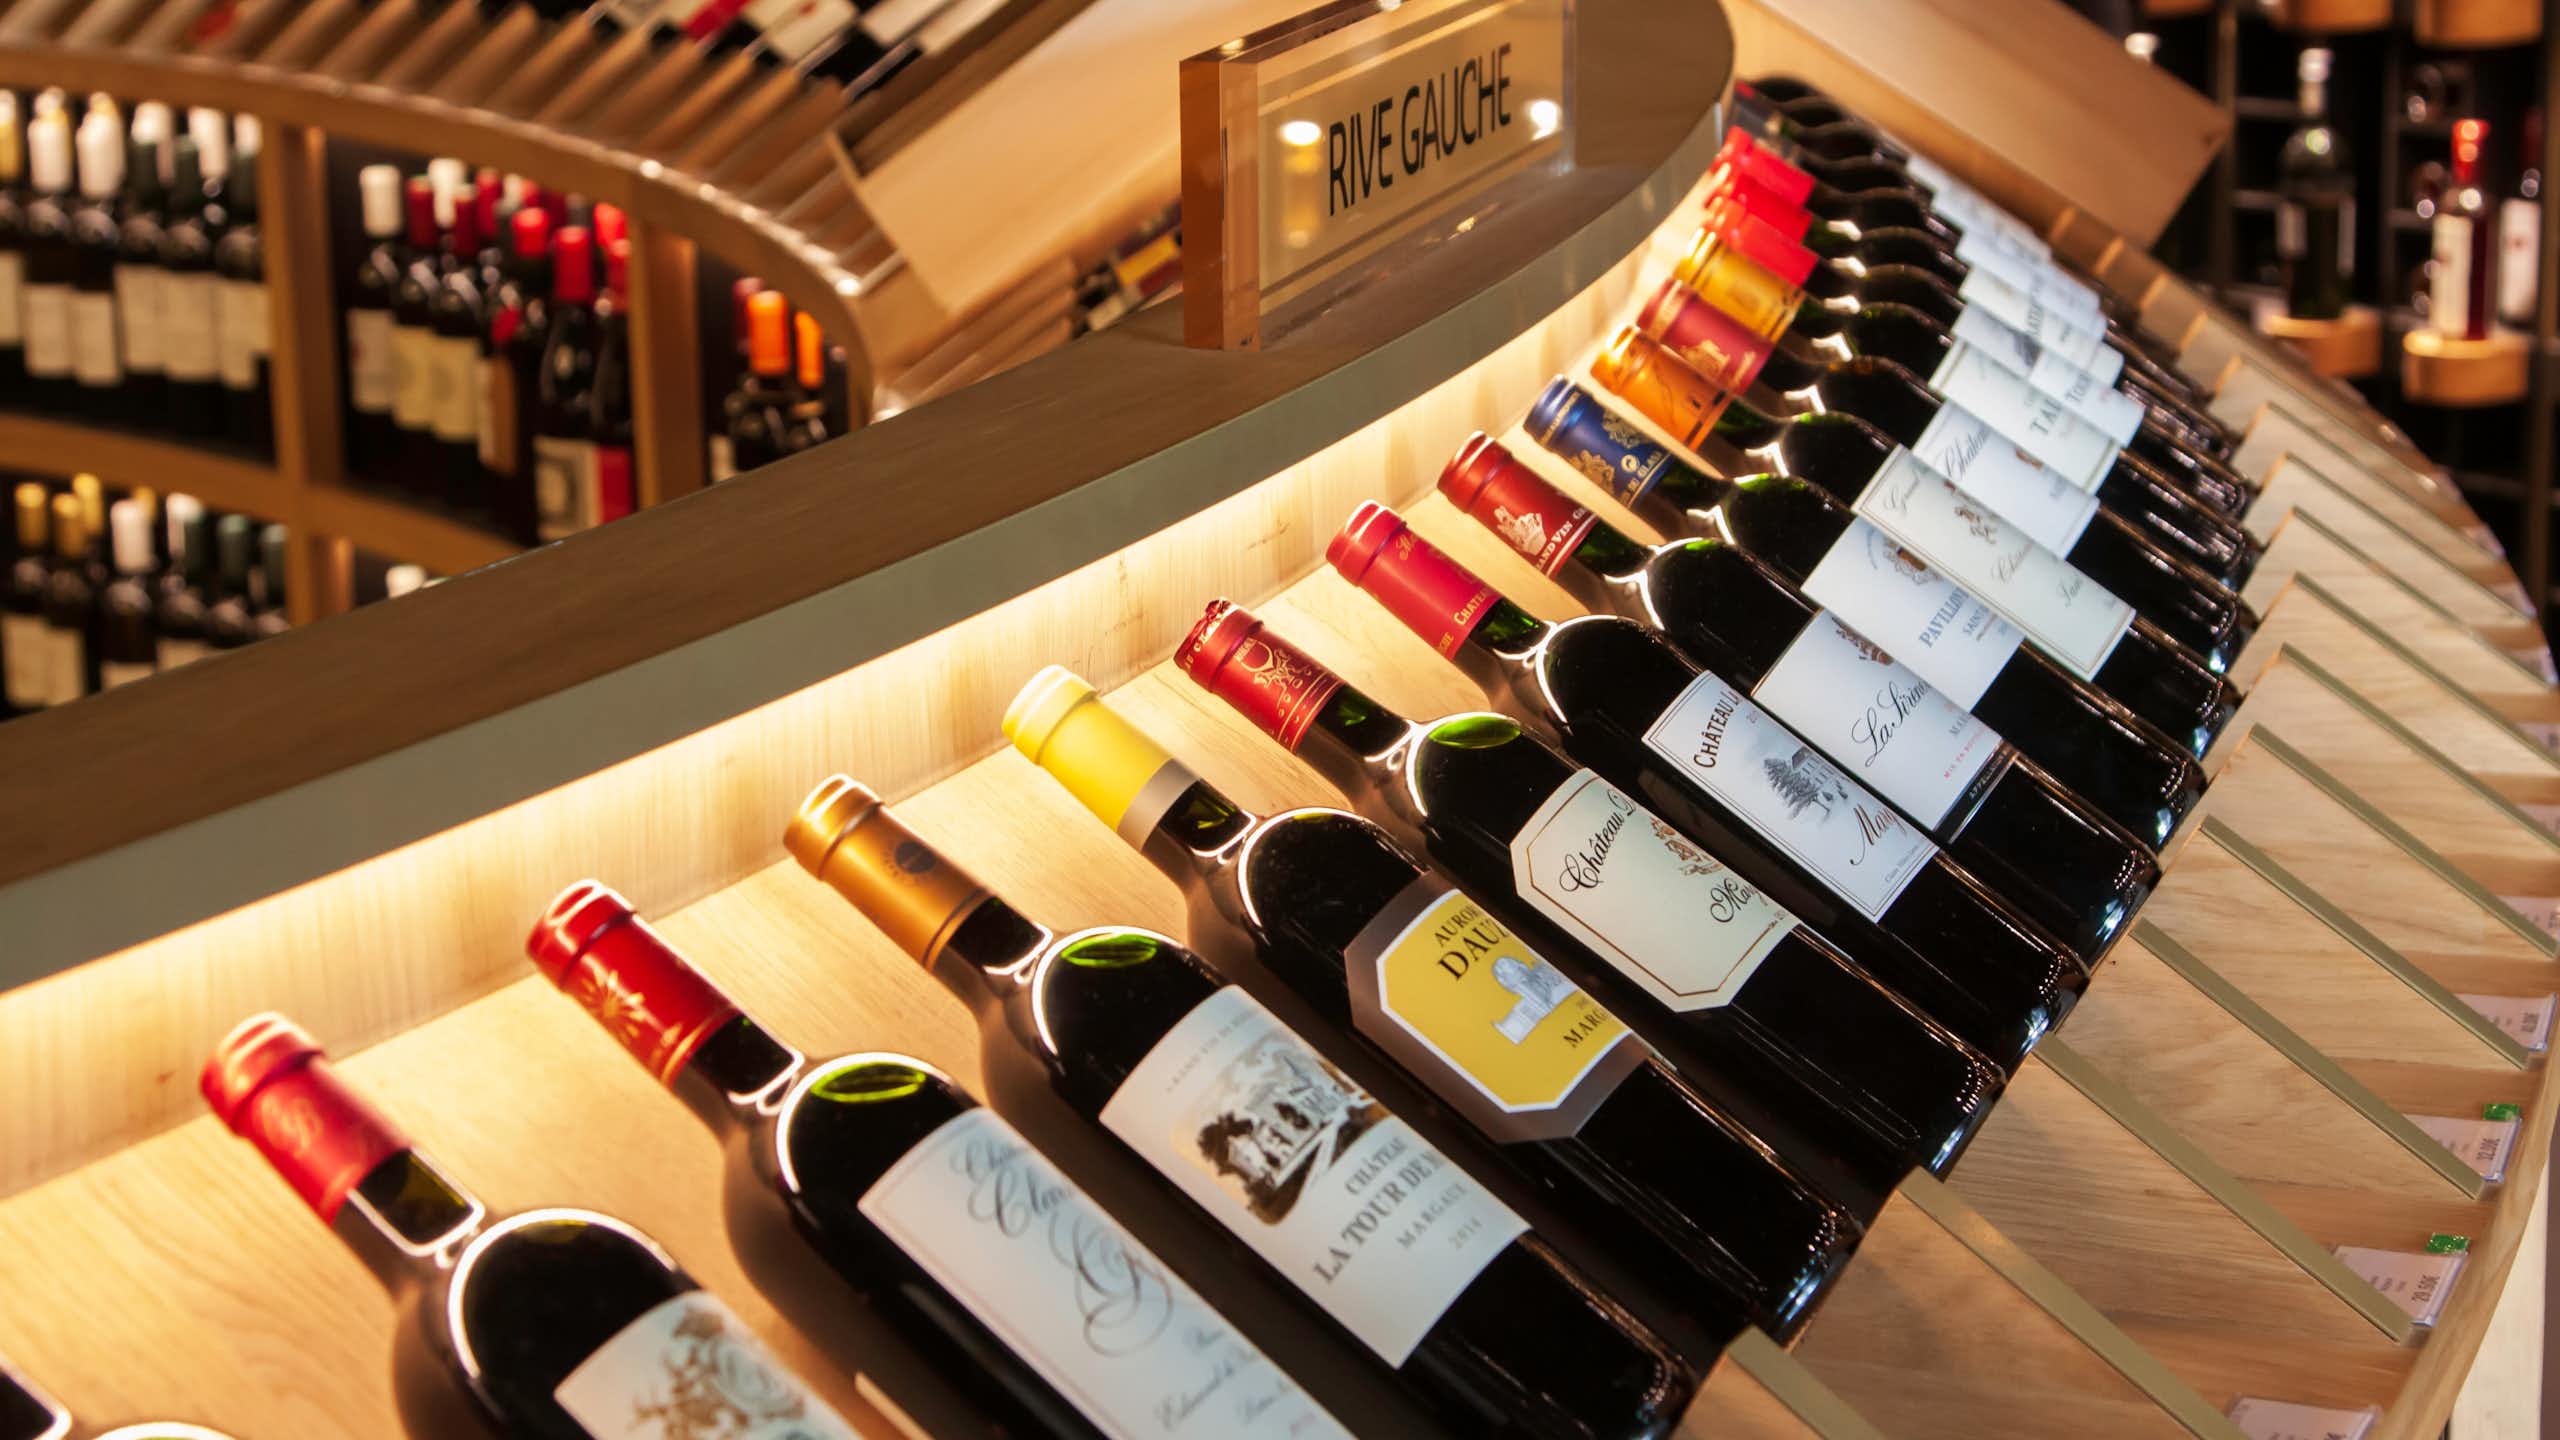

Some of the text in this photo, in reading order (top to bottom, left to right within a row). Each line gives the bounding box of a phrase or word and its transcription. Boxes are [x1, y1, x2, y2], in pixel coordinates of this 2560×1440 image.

[1329, 43, 1513, 217] RIVE GAUCHE
[1551, 520, 1574, 543] VIN
[1693, 699, 1734, 768] CHÂTEAU
[1851, 707, 1893, 768] La
[1559, 811, 1625, 892] Château
[1313, 1246, 1351, 1284] LA
[1342, 1183, 1408, 1246] TOUR
